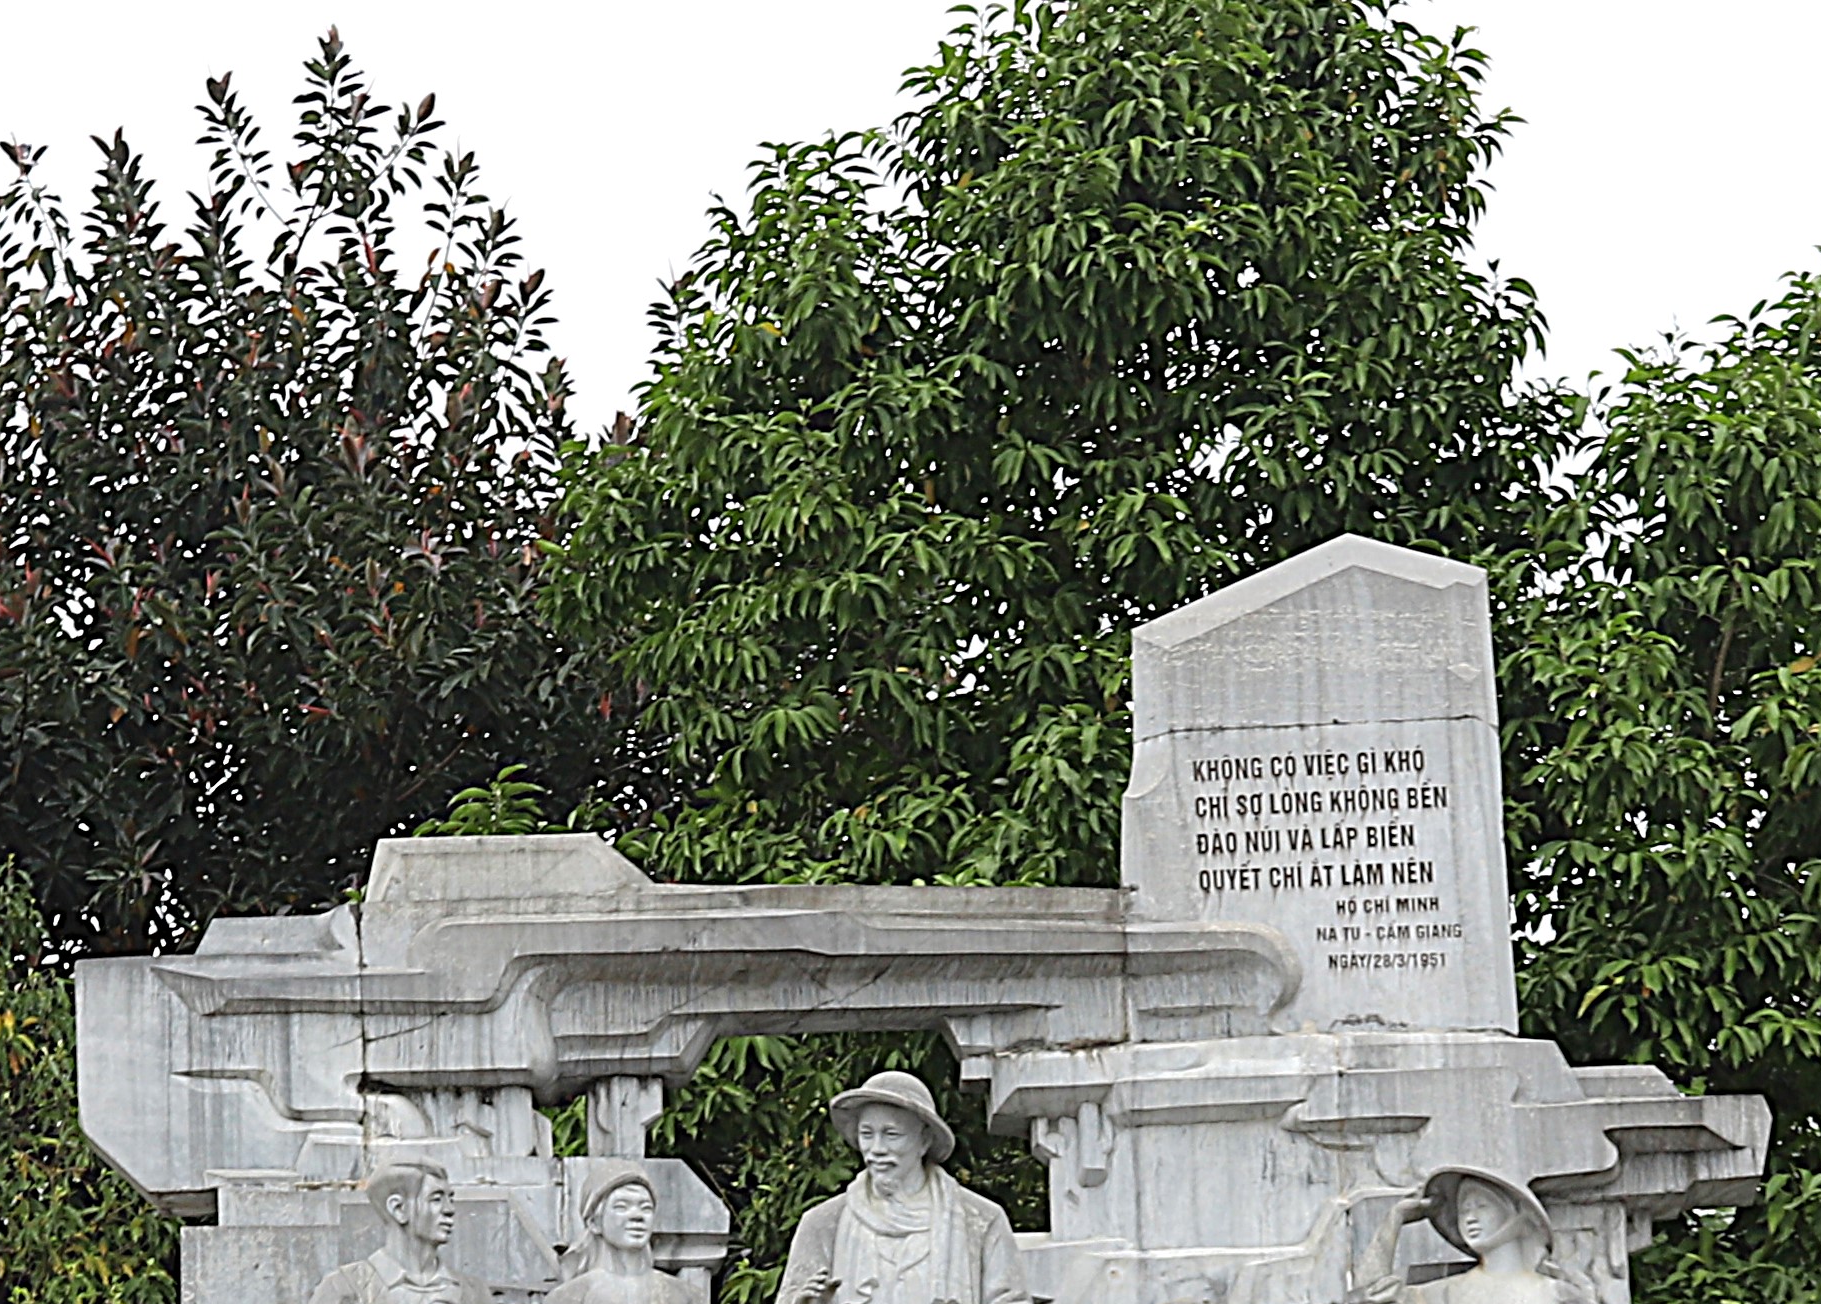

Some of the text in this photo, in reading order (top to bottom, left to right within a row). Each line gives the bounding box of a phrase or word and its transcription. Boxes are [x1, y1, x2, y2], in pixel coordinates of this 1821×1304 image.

[1193, 745, 1424, 781] KHÔNG CÓ VIỆC GÌ KHÓ
[1196, 786, 1228, 818] CHỈ
[1237, 792, 1263, 821] SỢ
[1270, 787, 1322, 814] LÒNG
[1330, 784, 1398, 812] KHÔNG
[1196, 815, 1414, 854] ĐÀO NÚI VÀ LẤP BIỂN
[1199, 860, 1261, 892] QUYẾT
[1270, 861, 1302, 888] CHÍ
[1341, 859, 1383, 886] LÀM
[1392, 857, 1433, 884] NÊN
[1363, 895, 1389, 914] CHÍ
[1396, 897, 1439, 912] MINH
